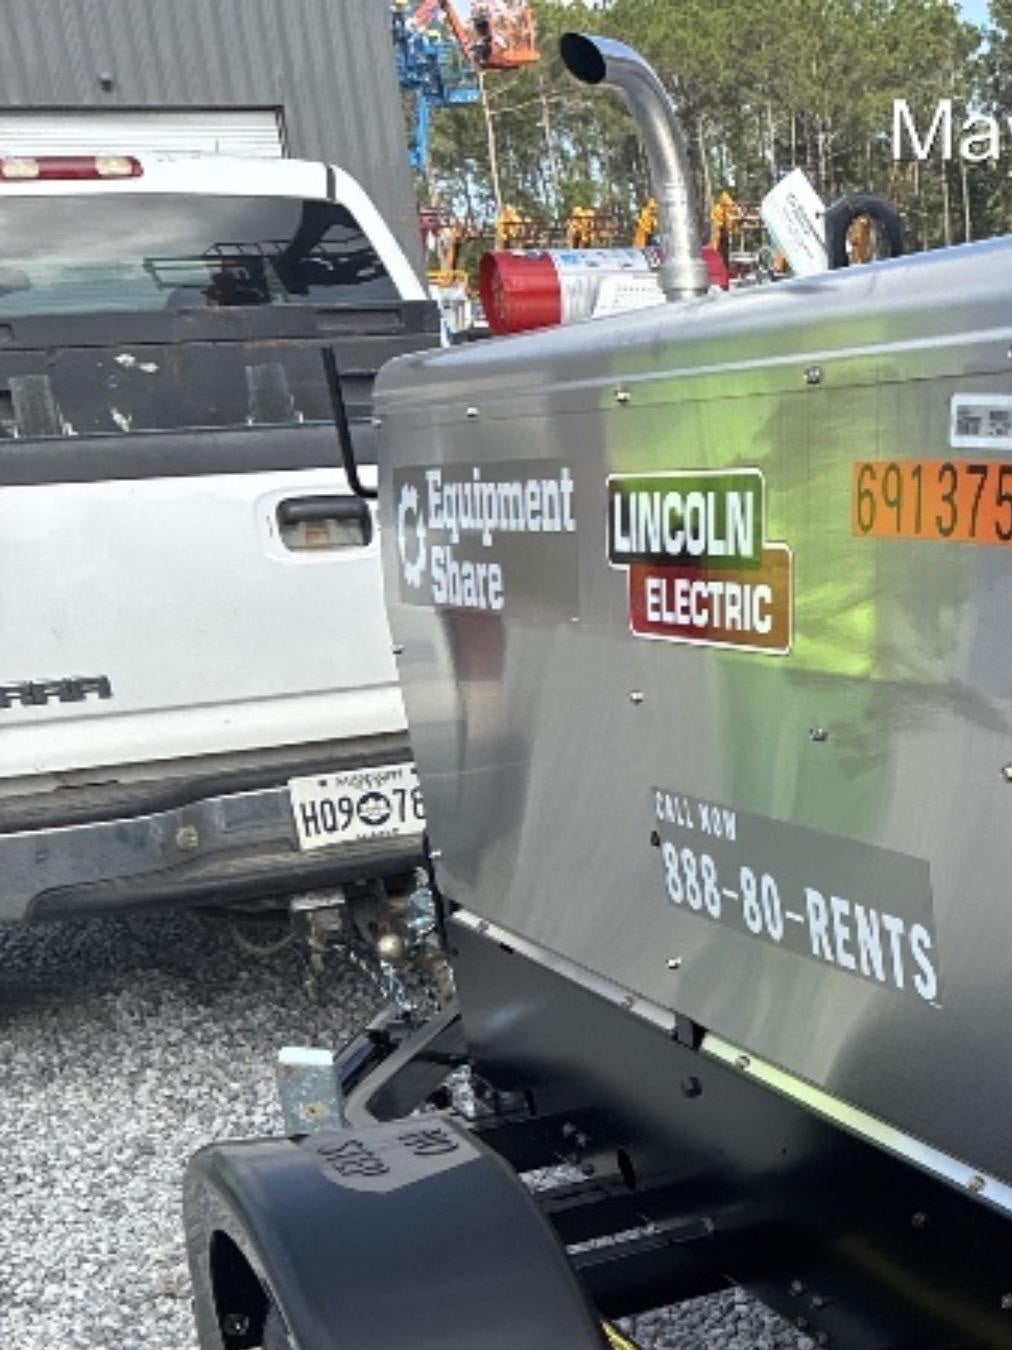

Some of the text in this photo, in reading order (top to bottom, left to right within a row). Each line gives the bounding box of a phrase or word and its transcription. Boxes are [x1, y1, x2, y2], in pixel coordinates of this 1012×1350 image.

[424, 467, 577, 547] Equipment
[611, 491, 755, 558] LINCOLN
[430, 545, 506, 610] Share
[645, 578, 773, 635] ELECTRIC
[655, 791, 736, 841] CALL NOW
[661, 841, 938, 1001] 888-80-RENTS
